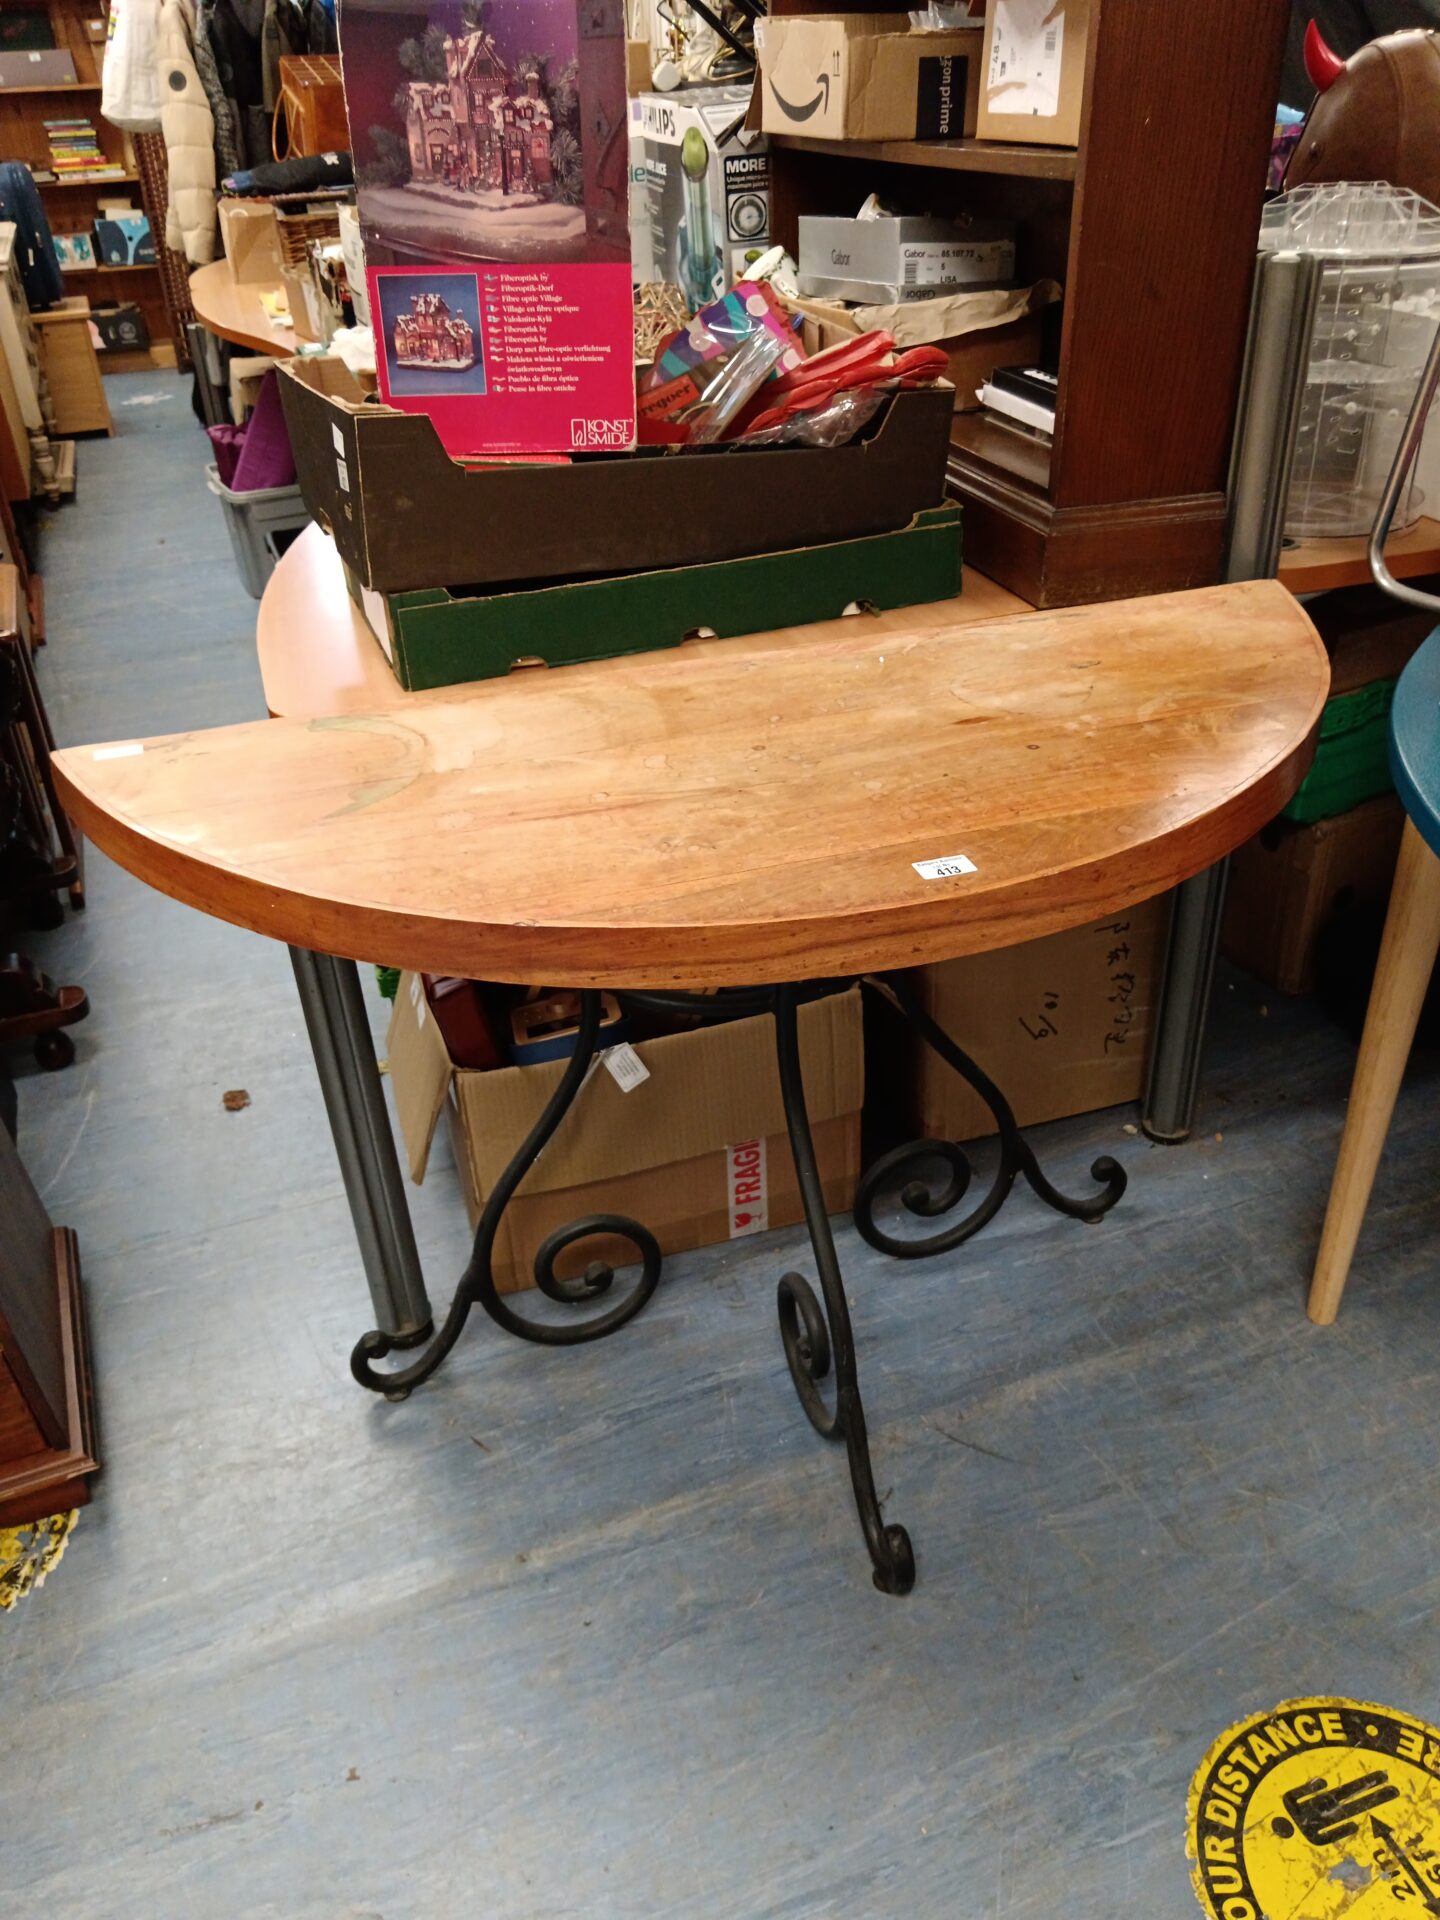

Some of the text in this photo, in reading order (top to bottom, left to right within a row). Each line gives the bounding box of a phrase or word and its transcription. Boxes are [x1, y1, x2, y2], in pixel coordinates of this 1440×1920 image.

[939, 86, 953, 134] prime
[726, 158, 766, 174] MORE
[831, 249, 851, 266] Gabor
[904, 249, 926, 258] Gabor
[501, 294, 520, 302] Fibre
[540, 294, 563, 303] Village
[502, 304, 526, 314] Village
[587, 419, 628, 432] KONST
[587, 432, 630, 445] SMIDE
[937, 865, 962, 876] 413
[1204, 1712, 1348, 1829] DISTANCE
